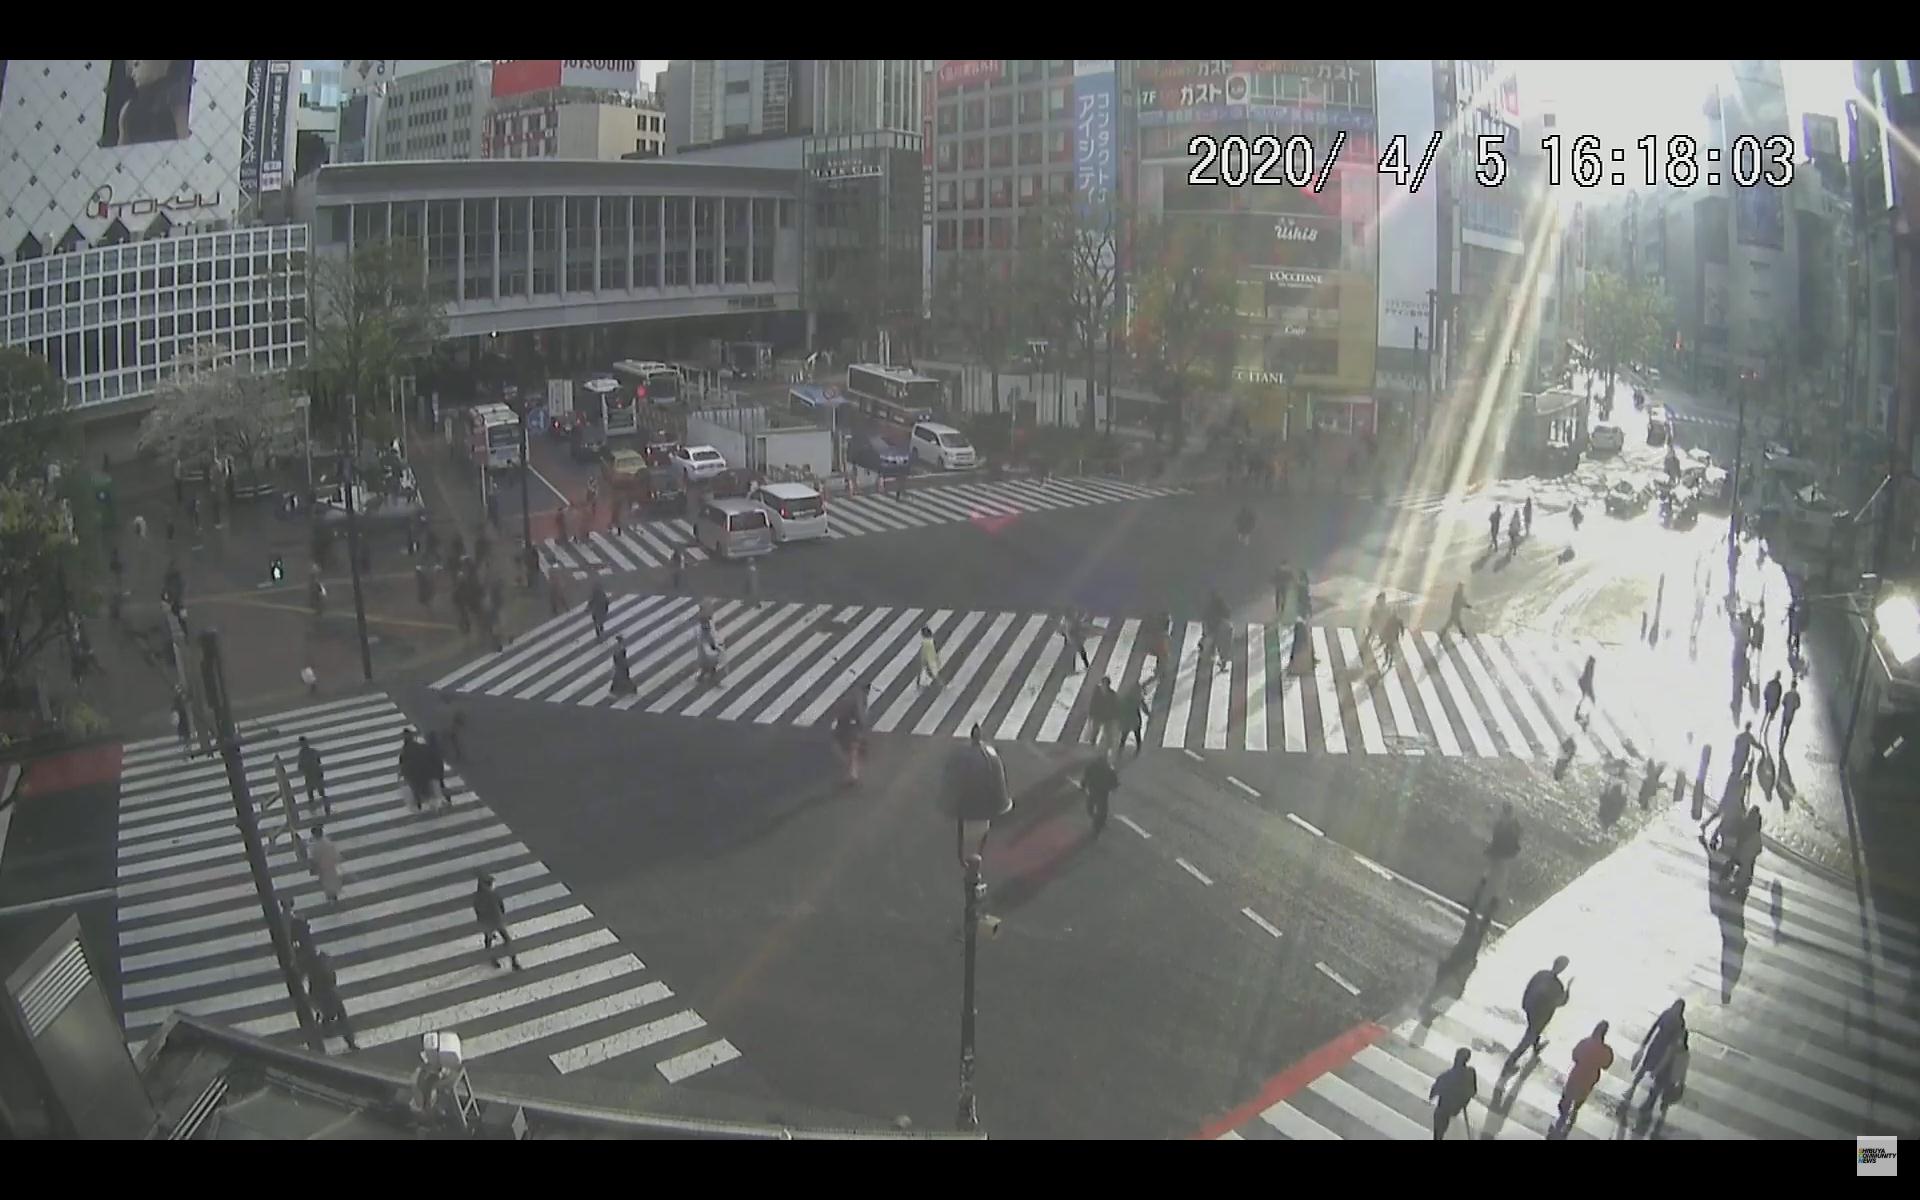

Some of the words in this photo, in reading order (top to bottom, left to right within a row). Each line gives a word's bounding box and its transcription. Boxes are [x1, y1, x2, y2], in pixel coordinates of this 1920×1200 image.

[1142, 91, 1157, 105] 7F
[1179, 83, 1222, 106] ガスト
